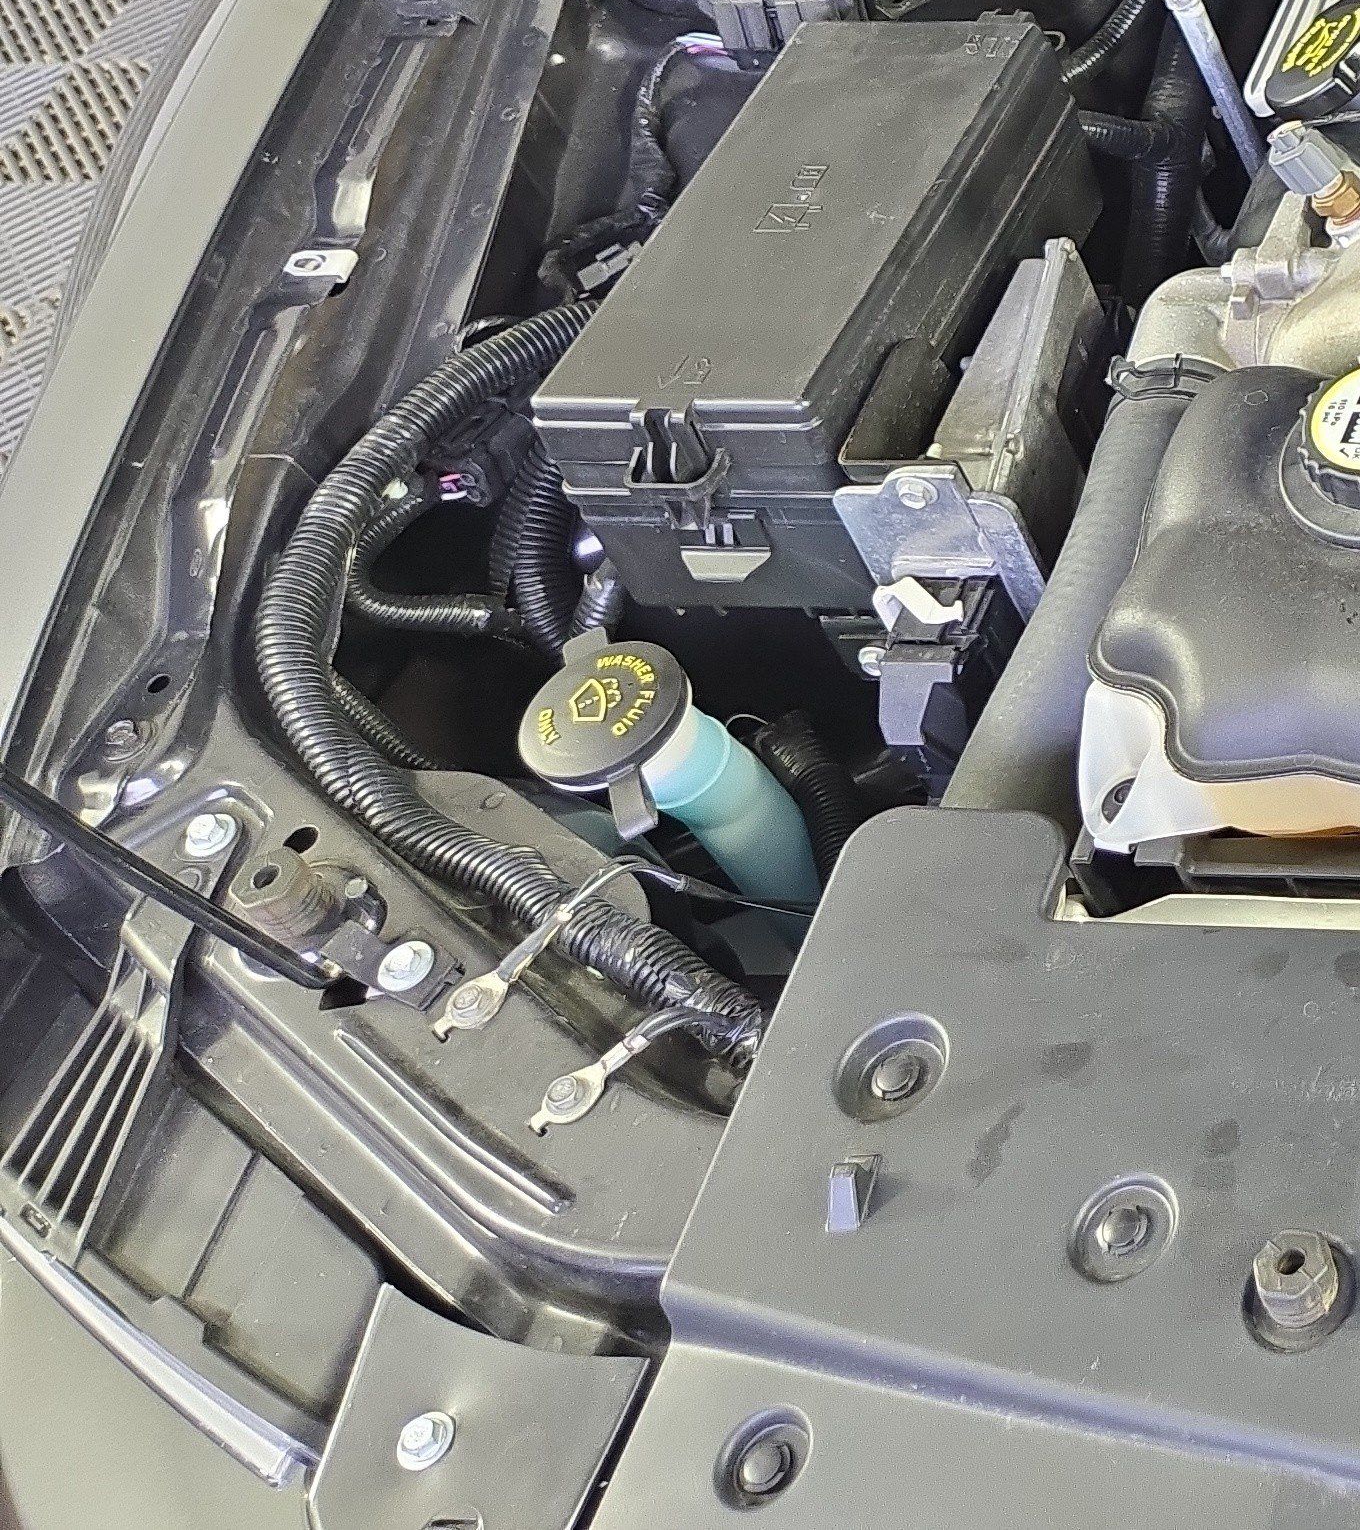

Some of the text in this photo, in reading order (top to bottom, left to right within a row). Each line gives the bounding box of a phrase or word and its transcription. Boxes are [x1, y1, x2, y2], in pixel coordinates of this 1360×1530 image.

[538, 708, 561, 746] ONLY
[597, 654, 656, 739] WASHER FLUID
